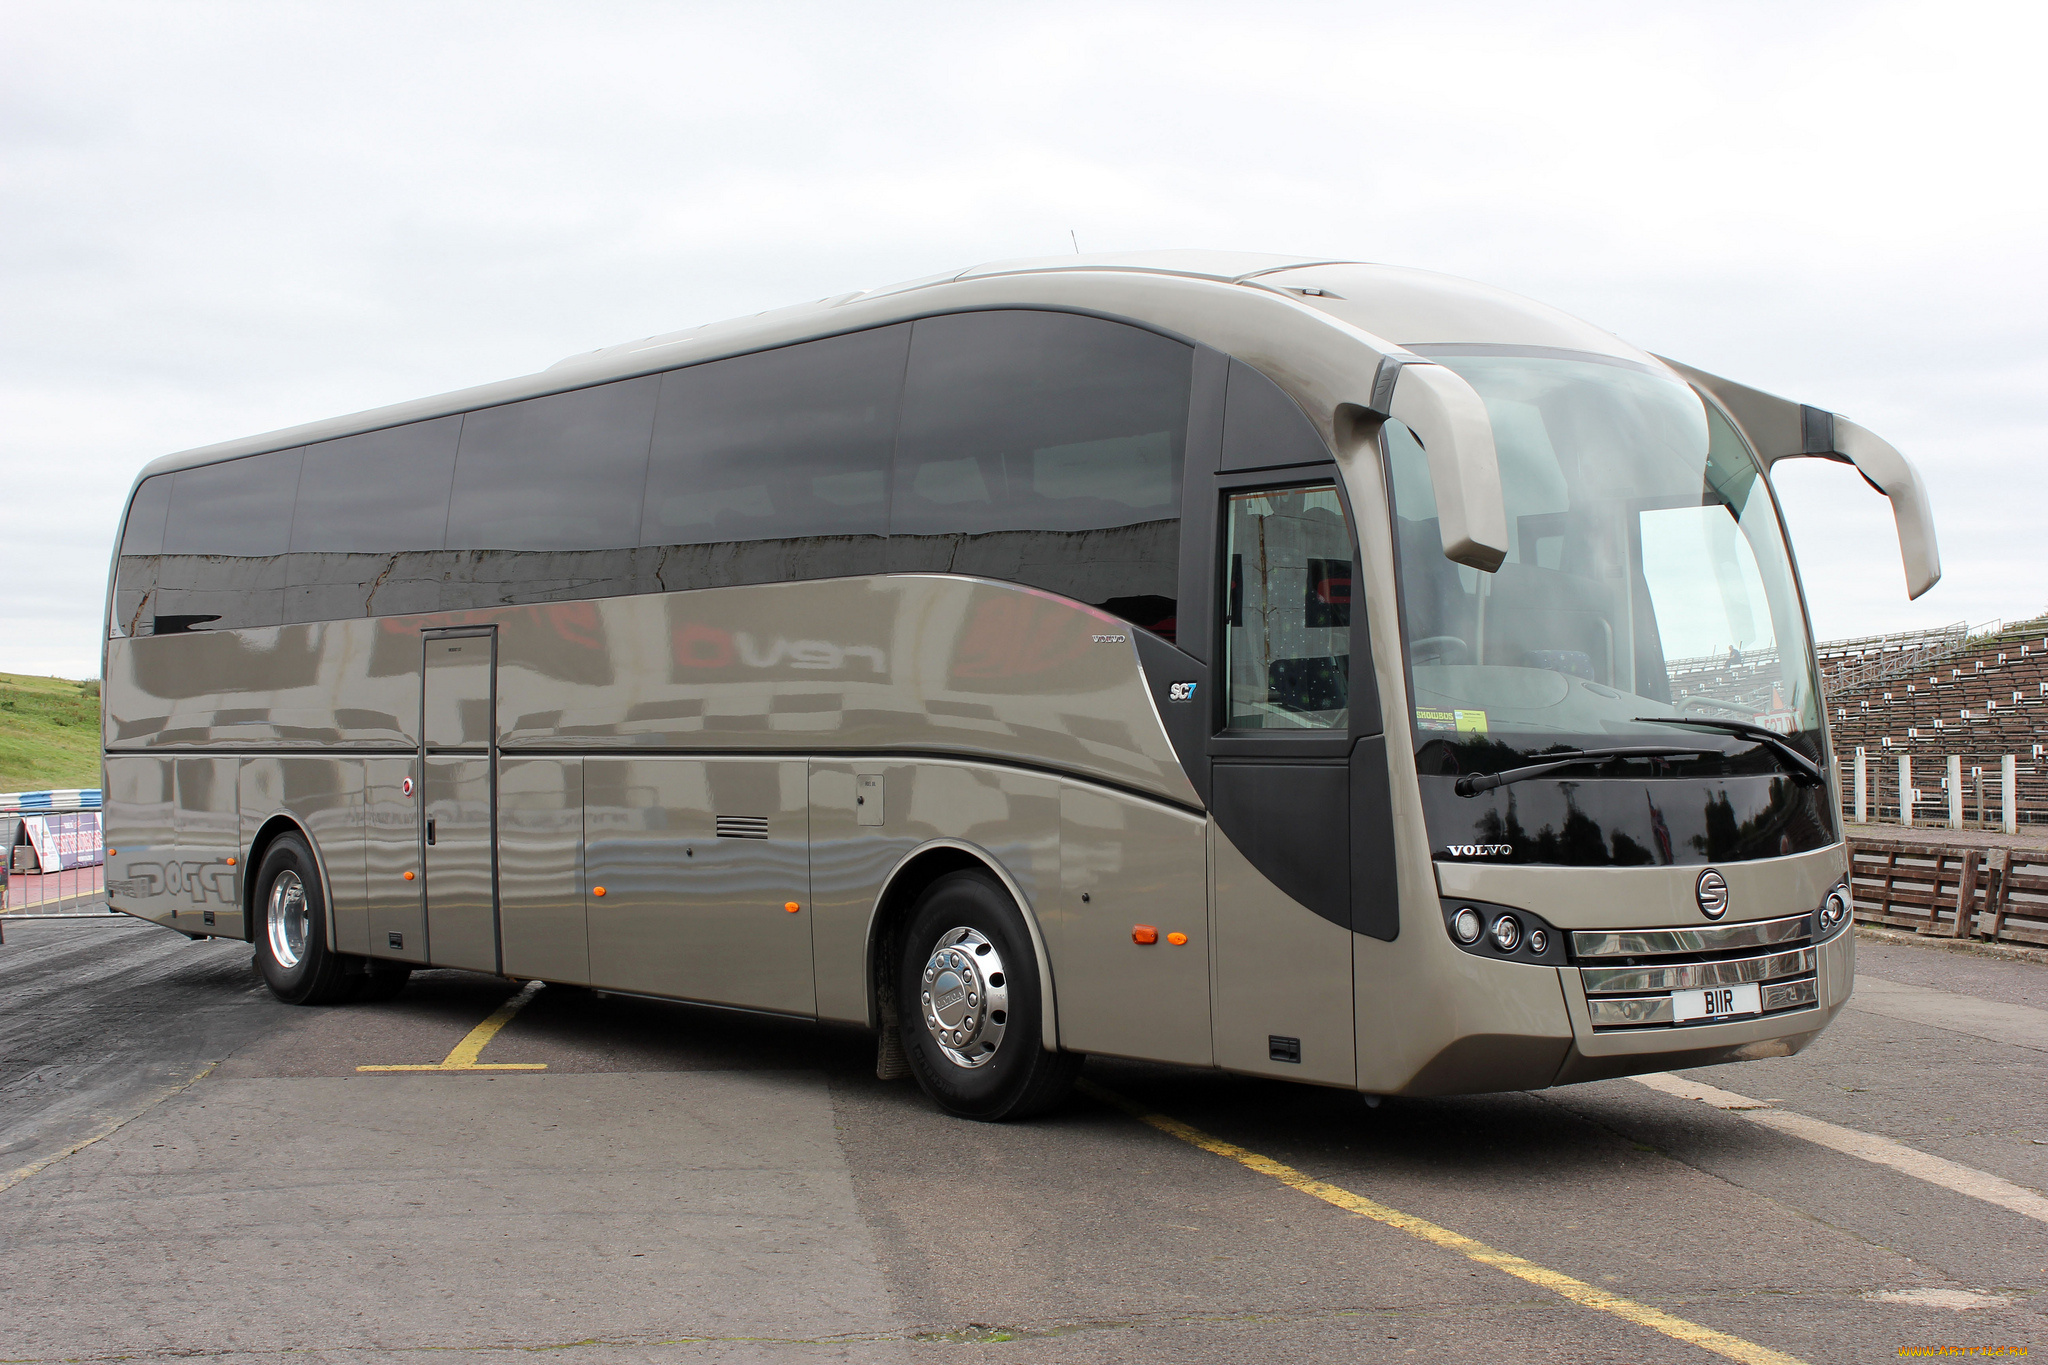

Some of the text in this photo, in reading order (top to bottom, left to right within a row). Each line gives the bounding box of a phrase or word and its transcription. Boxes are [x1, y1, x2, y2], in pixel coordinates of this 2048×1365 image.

[1091, 634, 1126, 643] VOLVO
[1169, 682, 1198, 701] SC7
[1446, 843, 1513, 856] VOLVO
